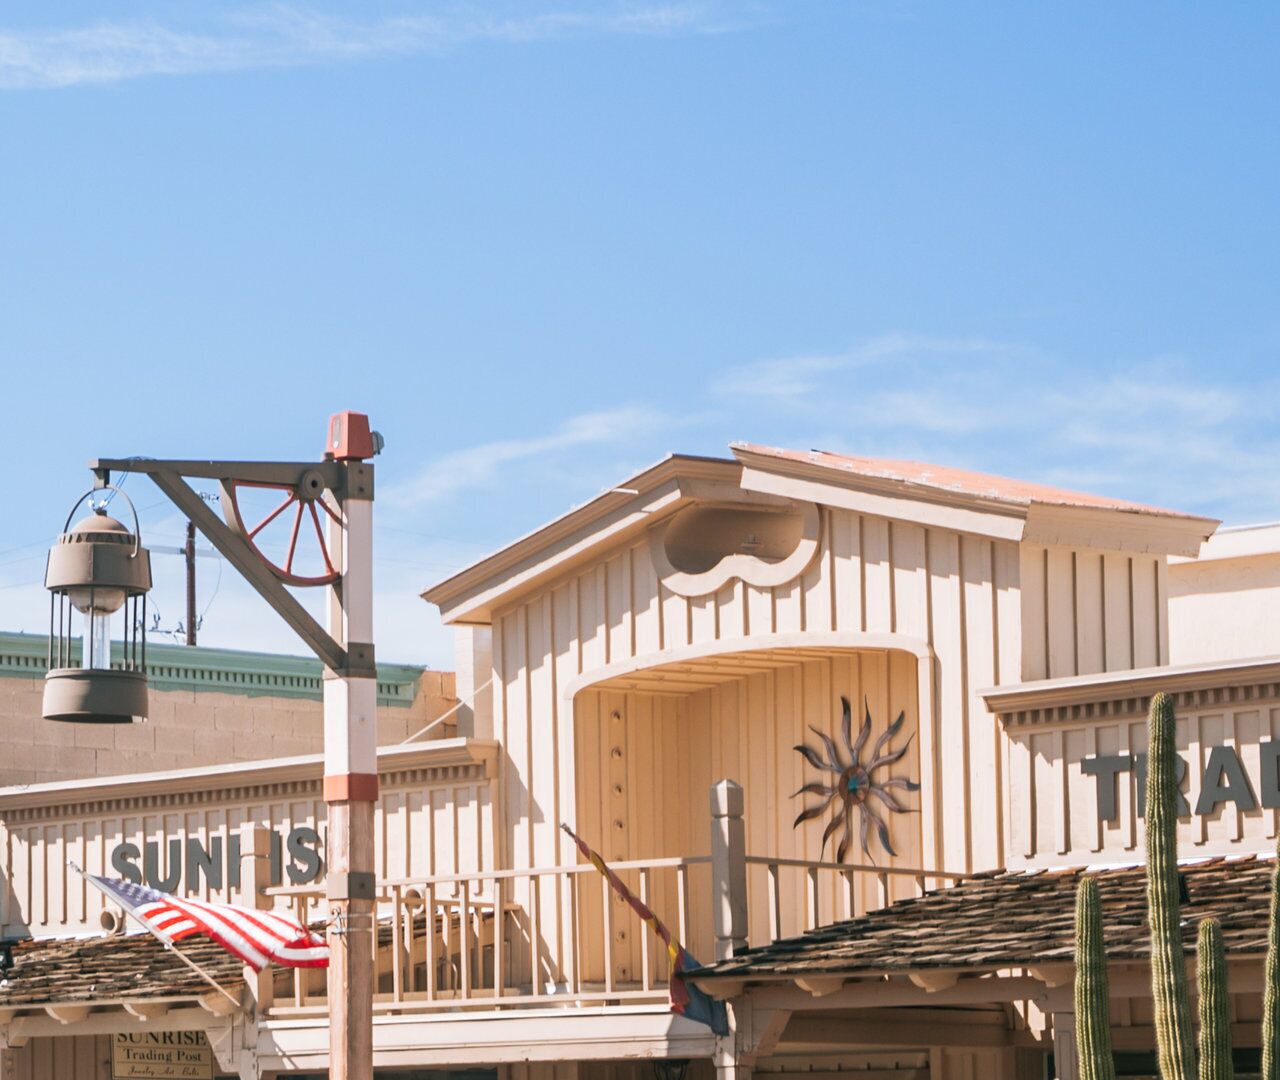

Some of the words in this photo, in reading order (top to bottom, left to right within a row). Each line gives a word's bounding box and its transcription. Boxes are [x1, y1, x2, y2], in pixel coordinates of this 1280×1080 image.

[111, 826, 328, 893] SUNIS
[117, 1030, 207, 1046] SUNRISE
[123, 1048, 173, 1063] Trading
[177, 1050, 203, 1062] Post
